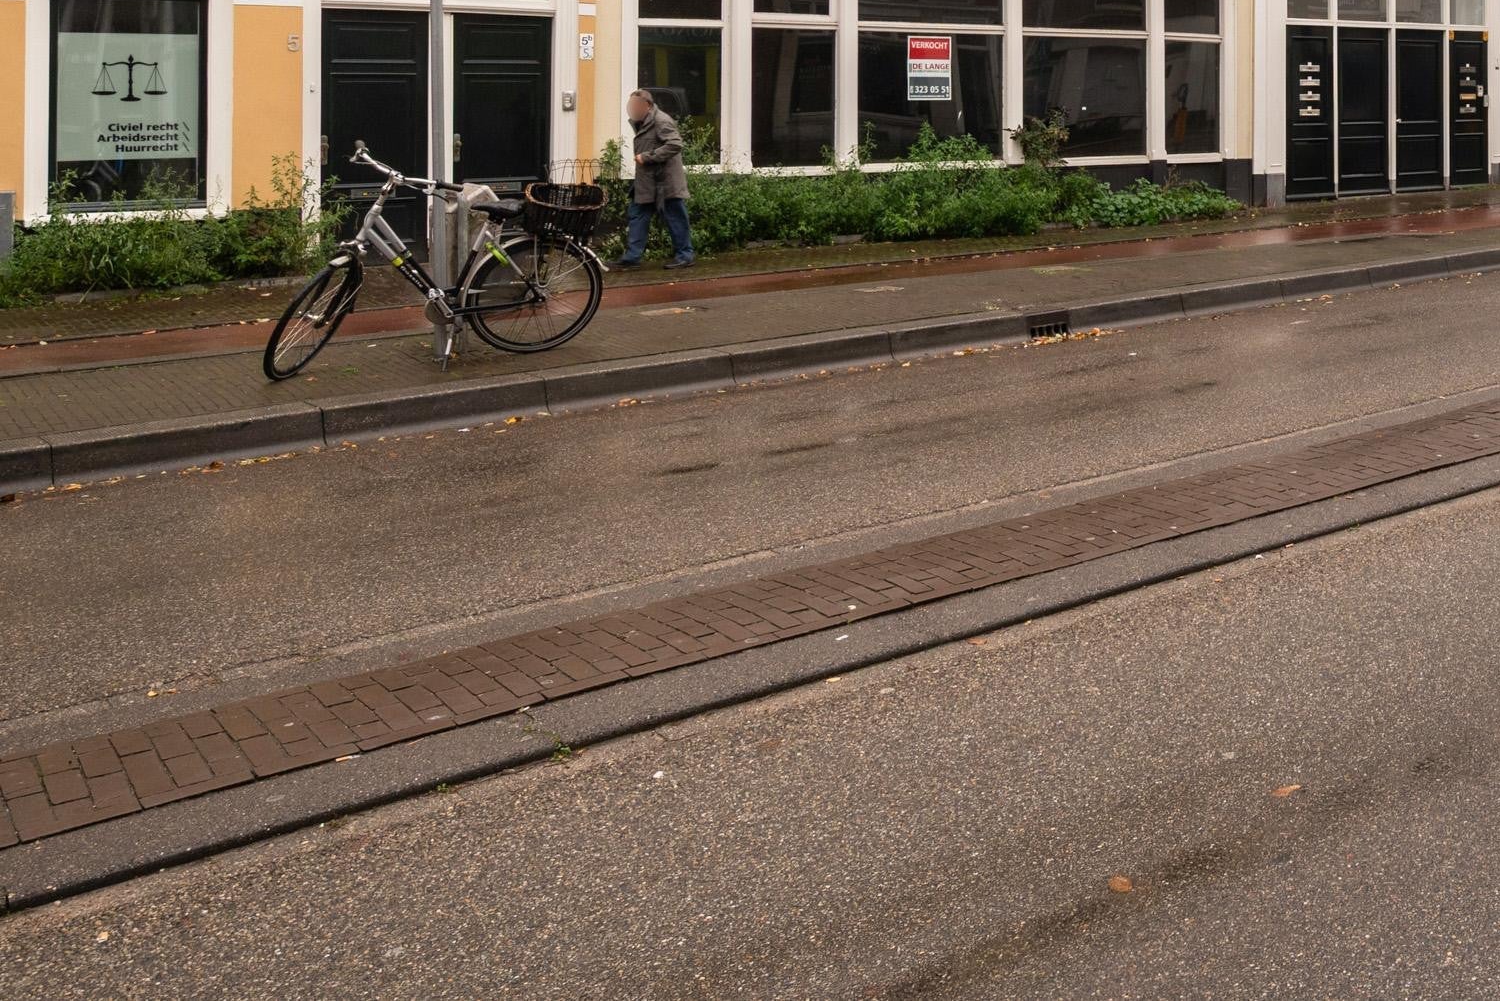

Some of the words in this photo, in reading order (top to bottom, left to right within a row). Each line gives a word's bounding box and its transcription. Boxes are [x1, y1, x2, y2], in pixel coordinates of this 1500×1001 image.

[287, 33, 300, 53] 5
[911, 41, 949, 50] VERKOCHT
[914, 85, 929, 94] 323
[930, 85, 940, 94] 05
[941, 85, 950, 94] 51
[108, 123, 143, 132] Civiel
[146, 122, 179, 131] recht
[97, 133, 179, 143] Arbeidsrecht
[115, 143, 179, 153] Huurrecht
